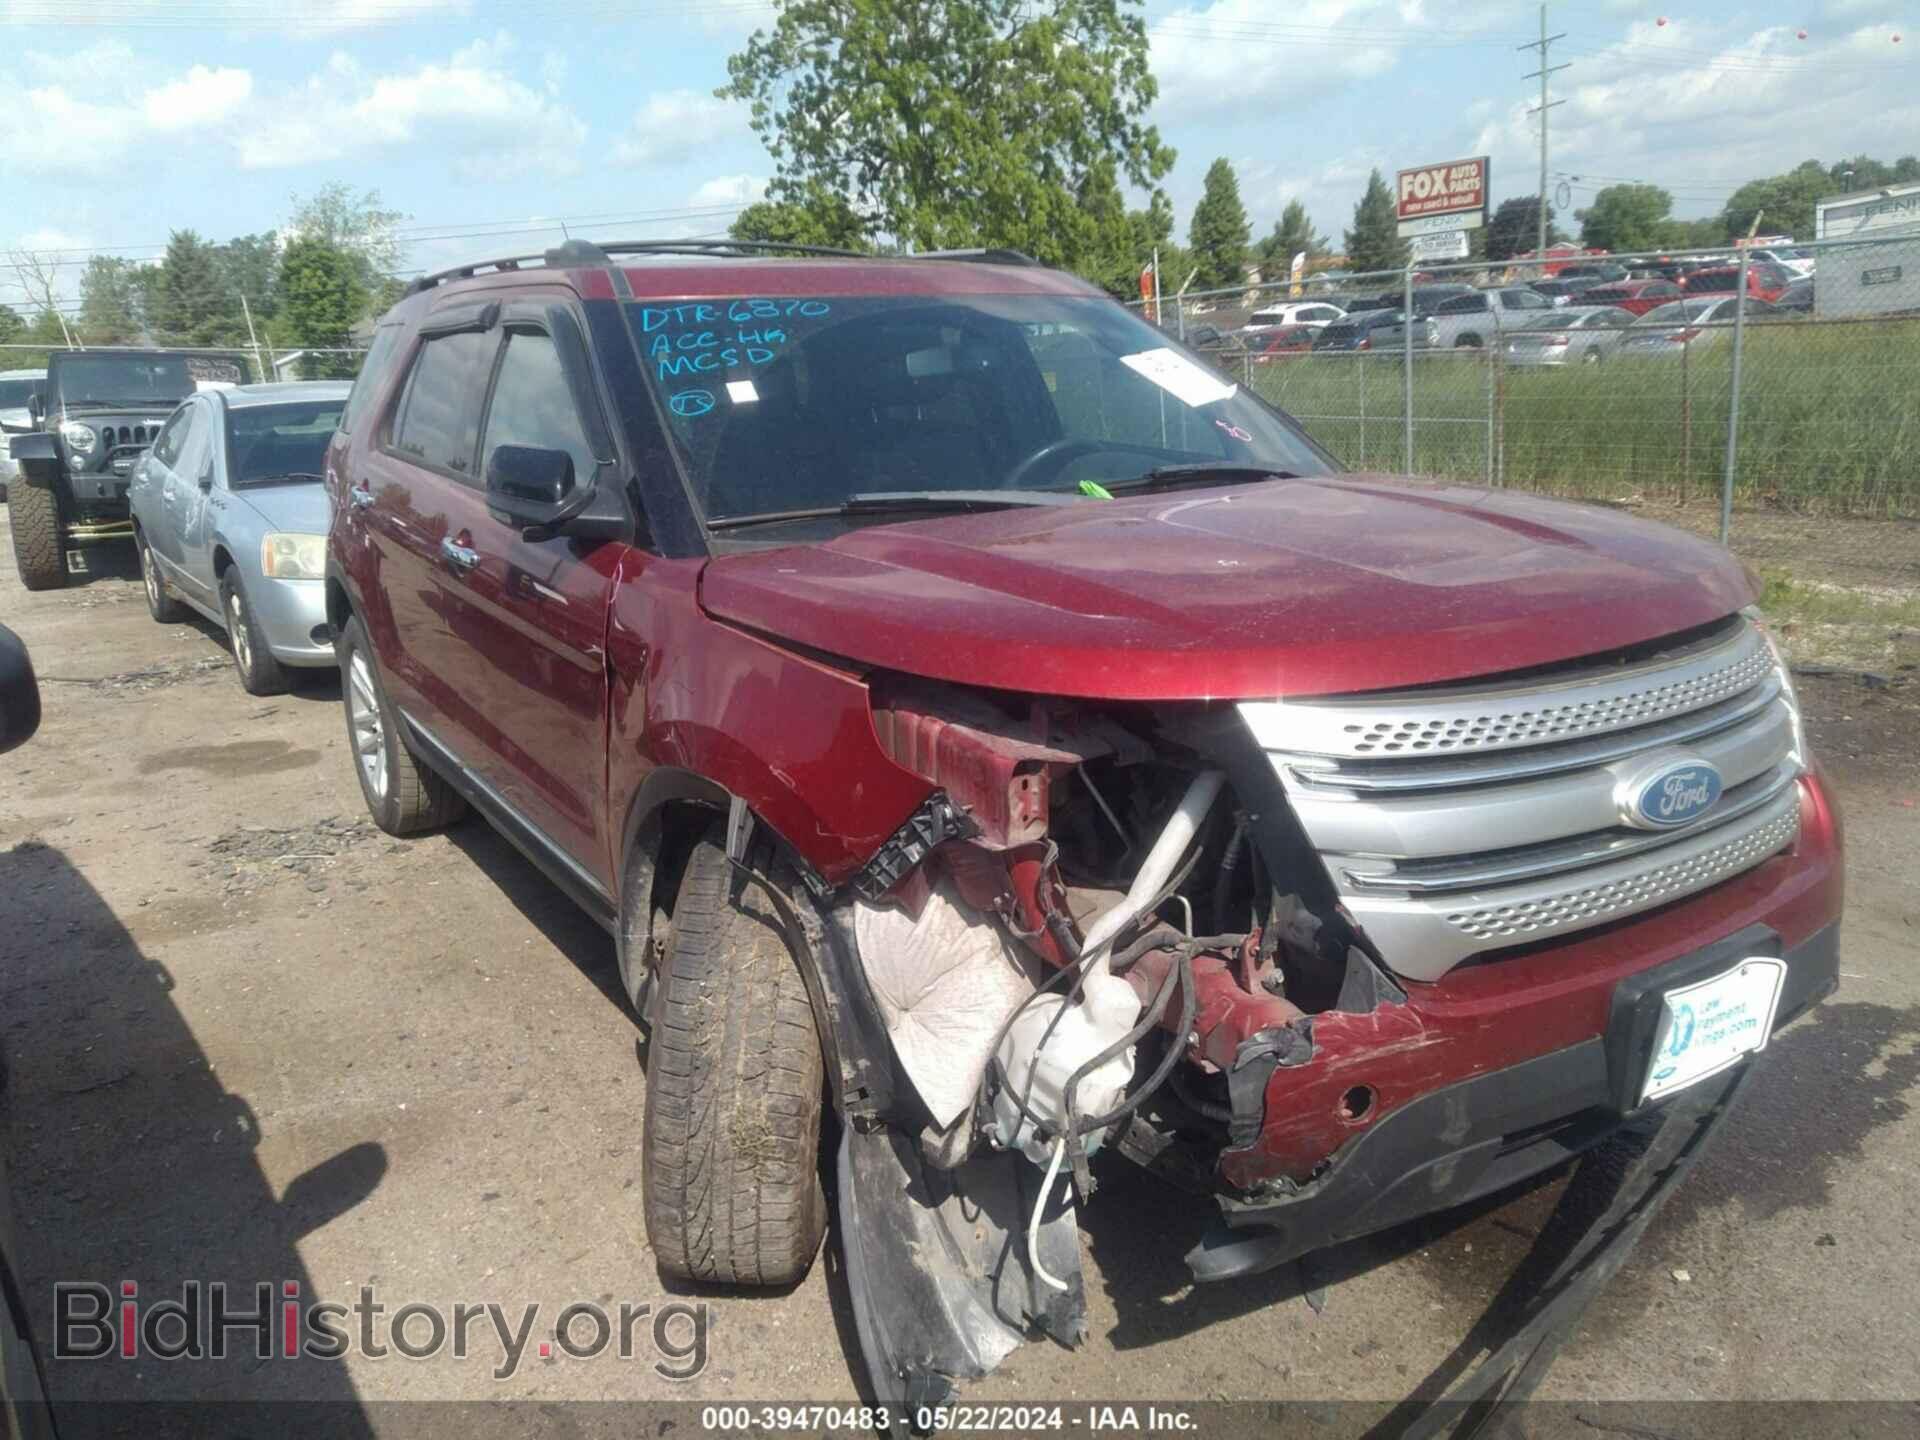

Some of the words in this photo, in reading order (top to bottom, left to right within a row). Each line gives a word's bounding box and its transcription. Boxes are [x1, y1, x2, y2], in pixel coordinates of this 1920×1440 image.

[1449, 163, 1479, 179] AUTO
[1401, 168, 1449, 201] FOX
[1449, 177, 1481, 193] PARTS
[1660, 772, 1710, 816] Ford
